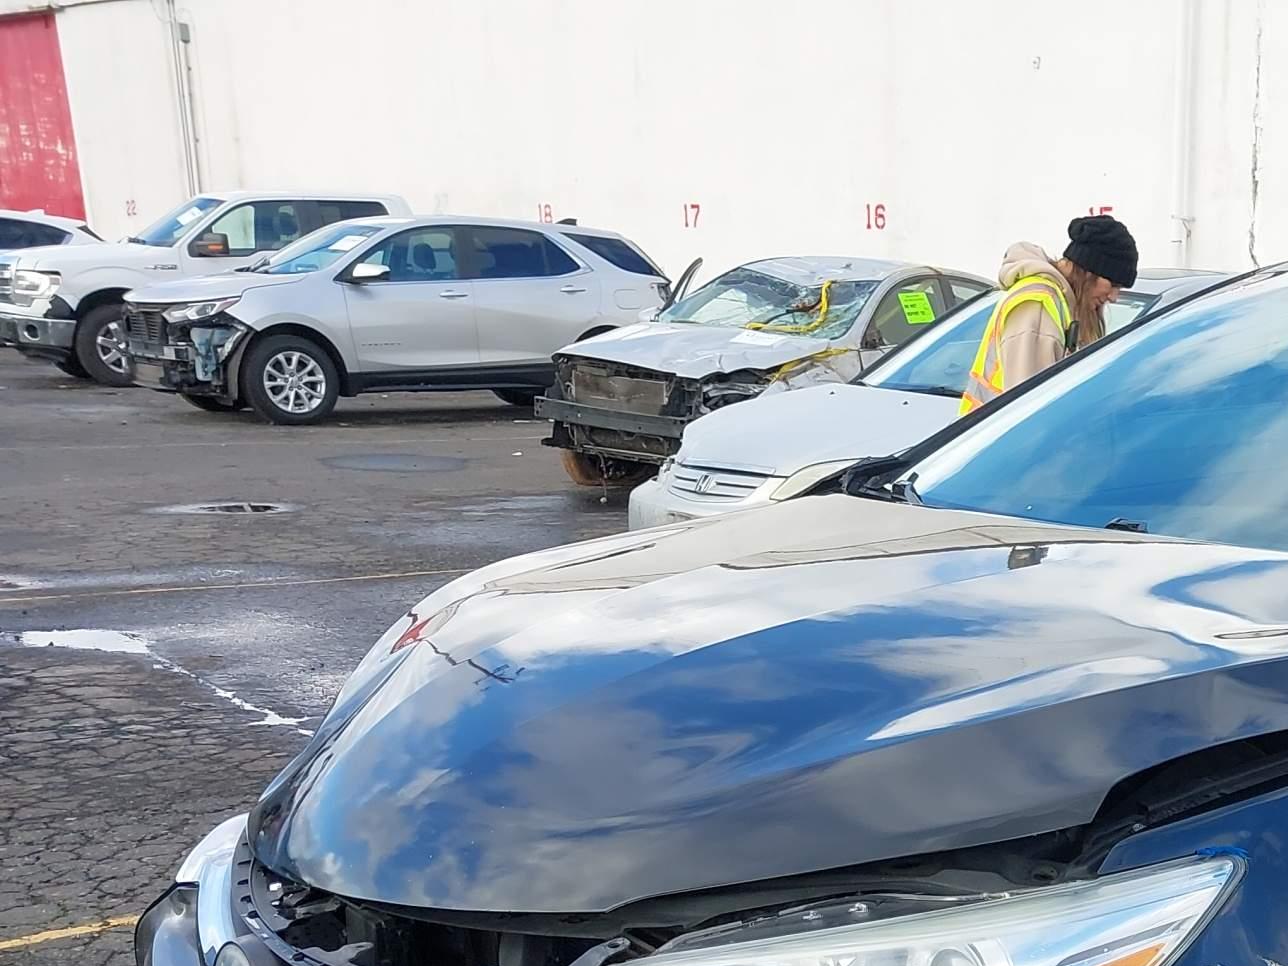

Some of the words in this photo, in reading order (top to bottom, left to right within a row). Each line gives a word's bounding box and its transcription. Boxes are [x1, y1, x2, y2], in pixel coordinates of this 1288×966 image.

[538, 203, 553, 224] 18
[683, 203, 701, 228] 17
[865, 203, 886, 230] 16
